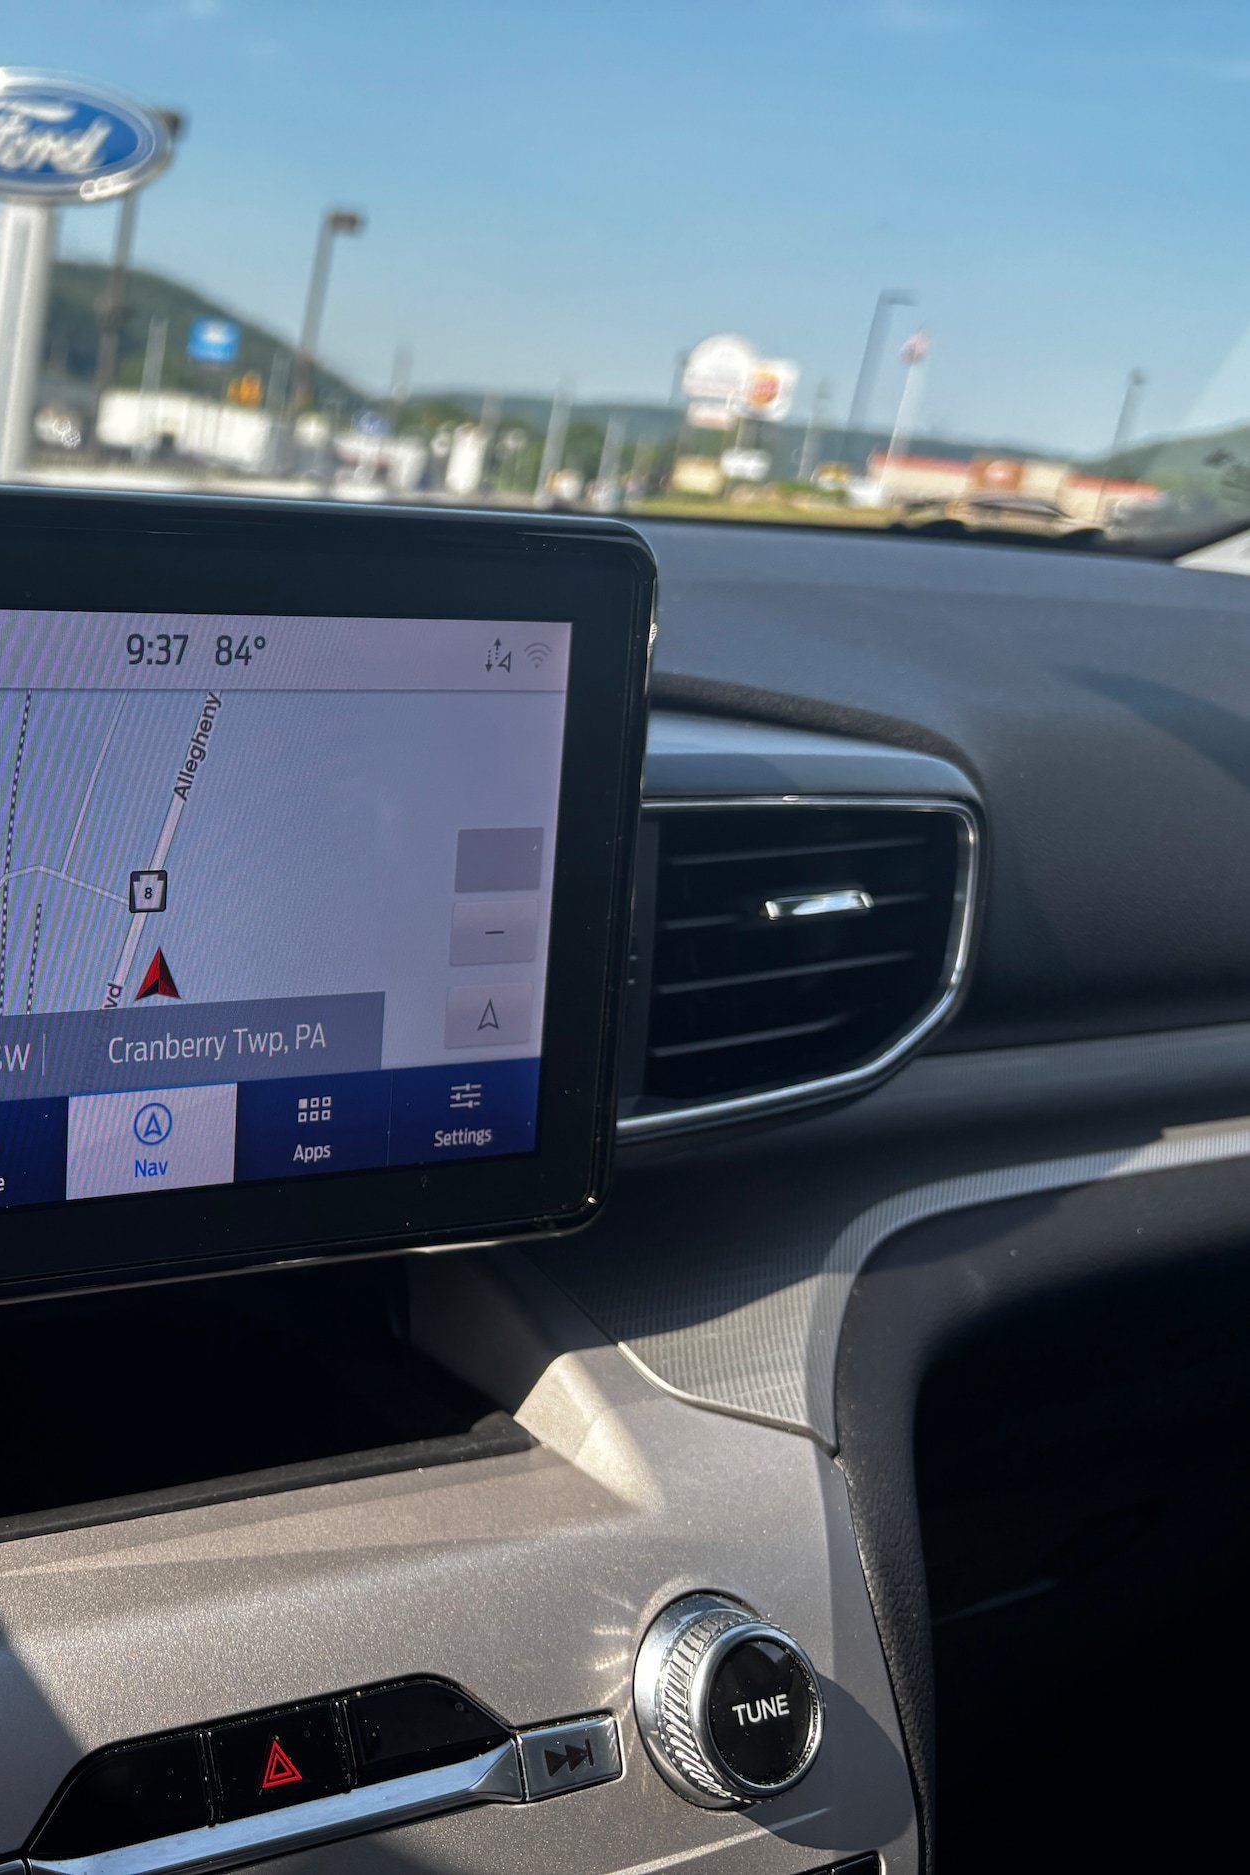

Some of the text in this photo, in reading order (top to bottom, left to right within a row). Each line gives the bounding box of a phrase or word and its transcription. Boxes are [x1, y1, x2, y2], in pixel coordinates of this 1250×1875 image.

[126, 634, 266, 667] 9:37 84°
[174, 690, 222, 802] Allegheny
[144, 887, 153, 900] 8
[104, 982, 123, 1009] vd
[108, 1029, 227, 1064] Cranberry
[233, 1026, 289, 1058] Twp,
[295, 1022, 327, 1051] PA
[433, 1127, 493, 1149] Settings
[293, 1143, 332, 1164] Apps
[134, 1159, 169, 1178] Nav
[732, 1693, 790, 1727] TUNE
